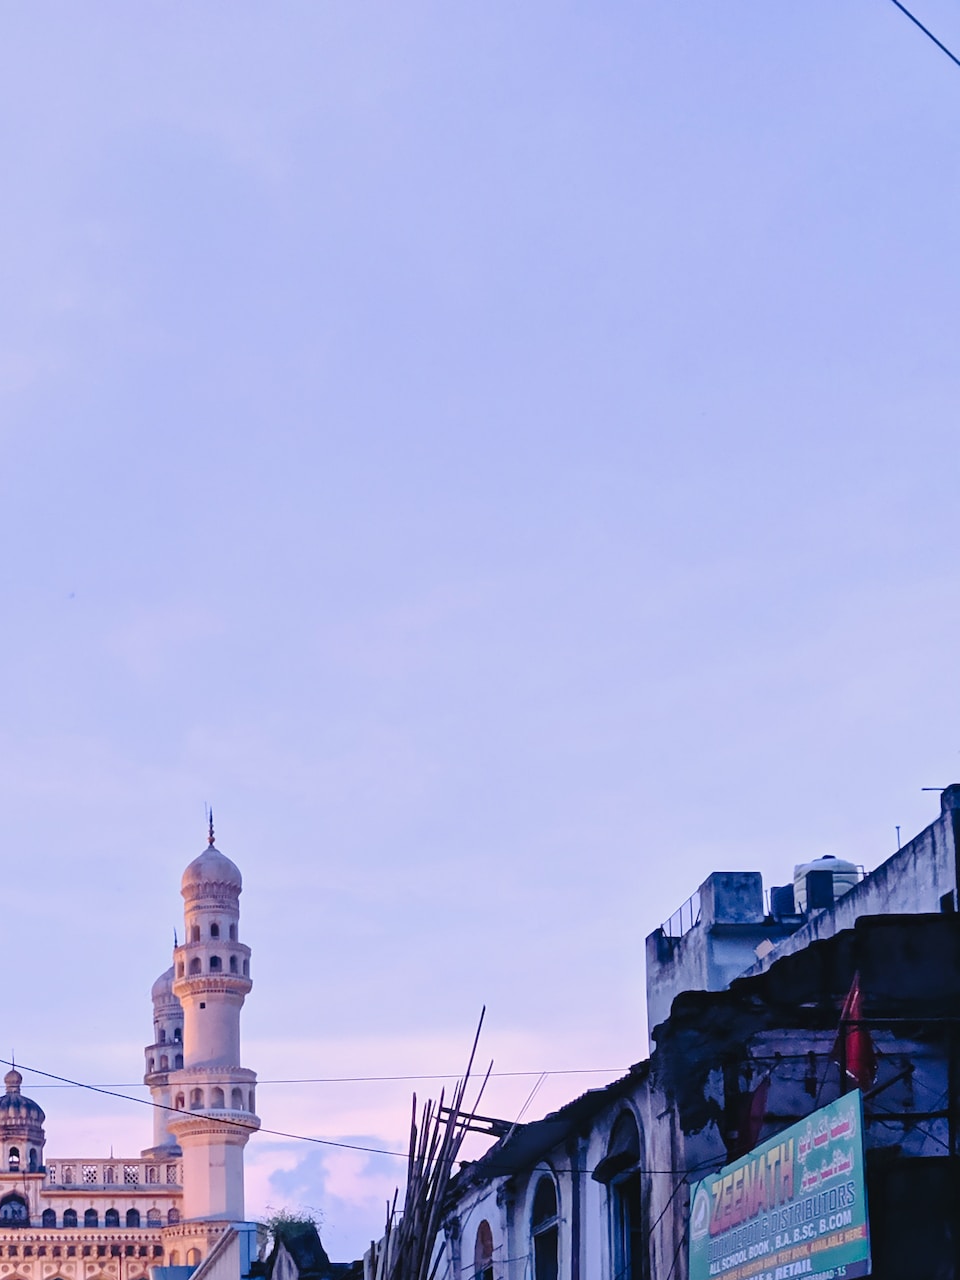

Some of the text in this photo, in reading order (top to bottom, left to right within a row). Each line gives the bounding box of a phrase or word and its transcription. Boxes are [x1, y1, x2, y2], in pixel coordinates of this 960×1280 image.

[710, 1138, 794, 1237] ZEENATH
[770, 1181, 855, 1235] DISTRIBUTORS
[709, 1261, 722, 1276] ALL
[722, 1250, 747, 1270] SCHOOL
[775, 1233, 791, 1249] B.A.
[819, 1210, 852, 1233] B.COM
[810, 1235, 844, 1252] AVAILABLE
[844, 1228, 863, 1243] HERE
[775, 1259, 812, 1280] RETAIL
